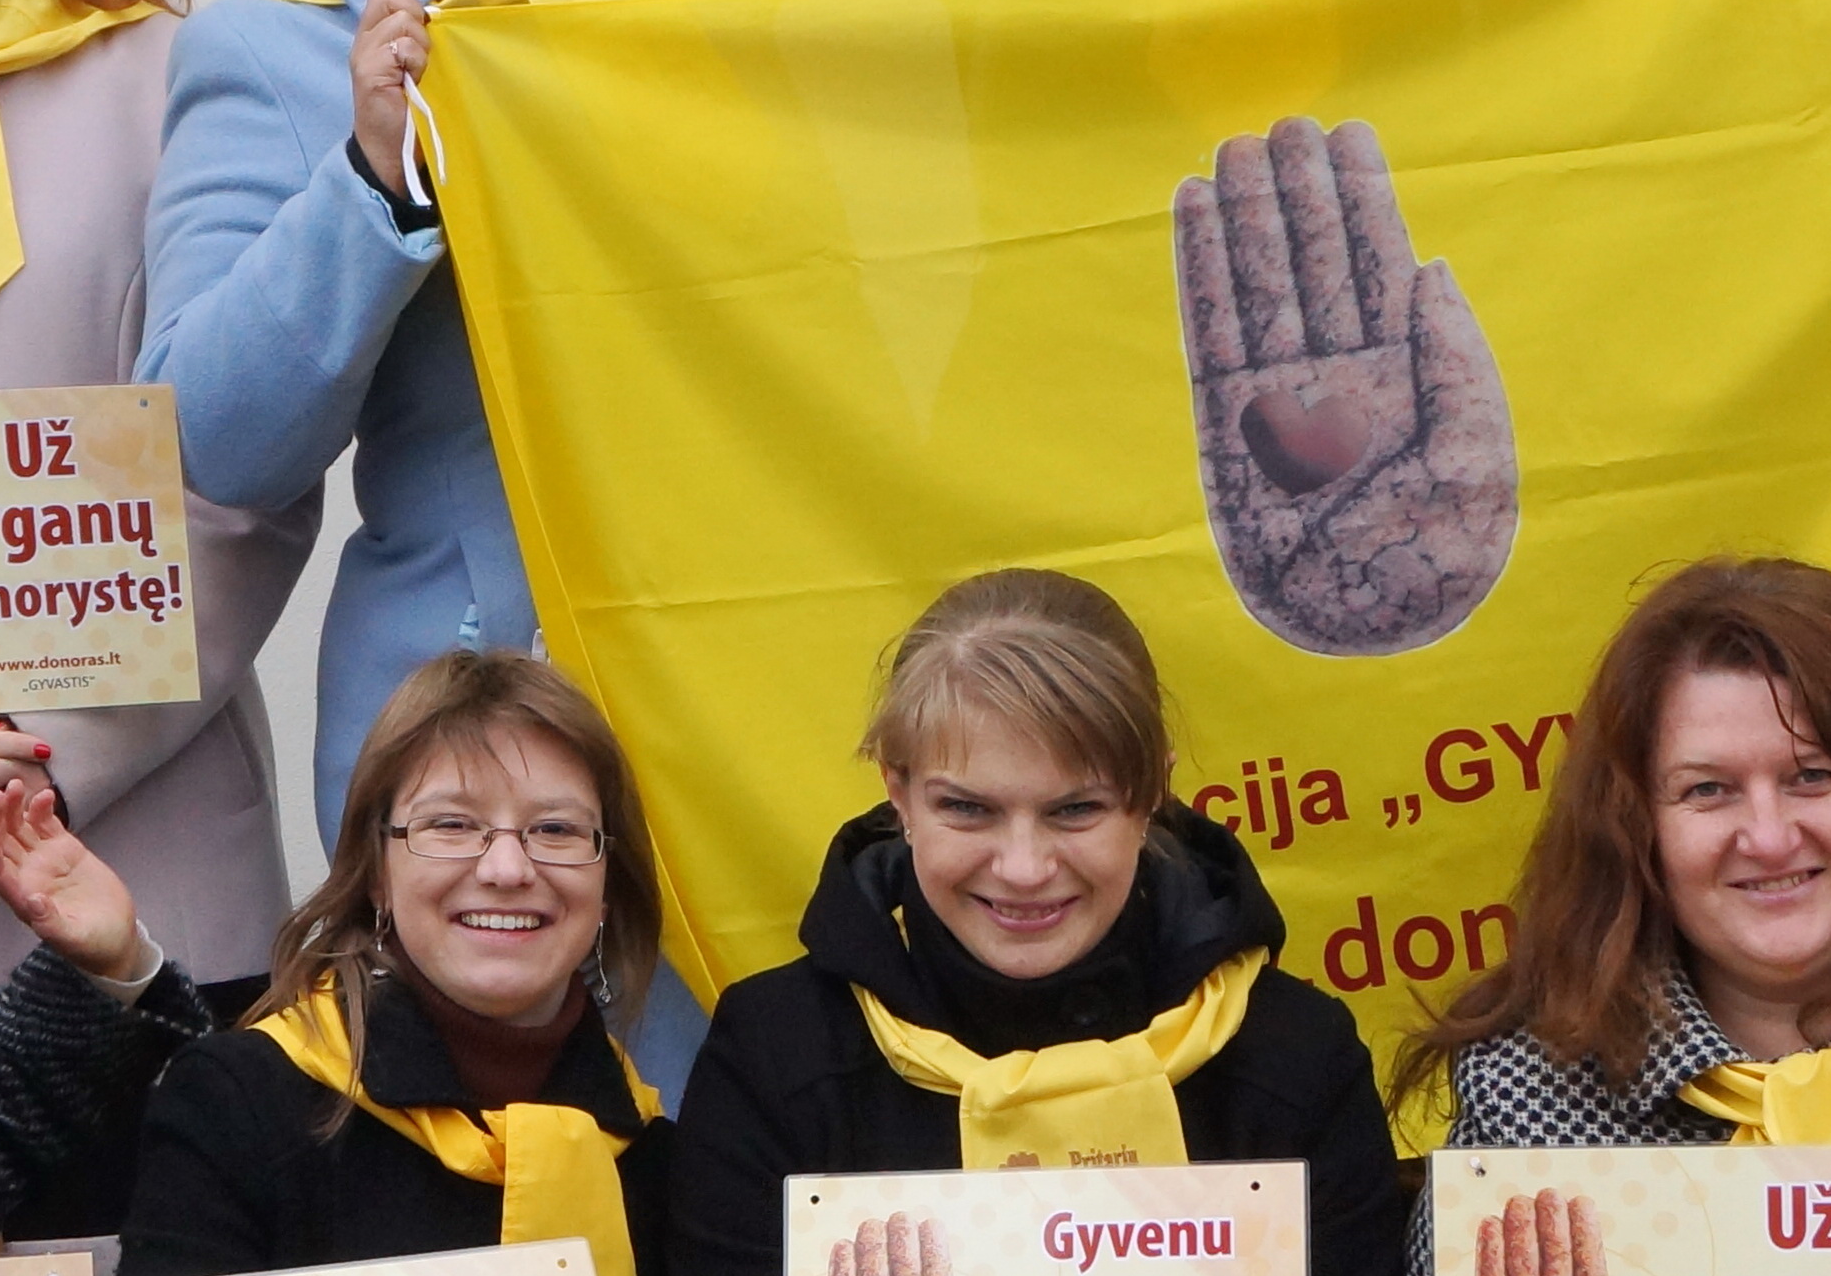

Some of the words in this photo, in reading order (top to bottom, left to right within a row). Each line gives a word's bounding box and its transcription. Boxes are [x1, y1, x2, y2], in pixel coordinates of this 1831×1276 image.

[6, 420, 75, 477] Už
[1191, 757, 1350, 851] cija
[1044, 1213, 1231, 1272] Gyvenu
